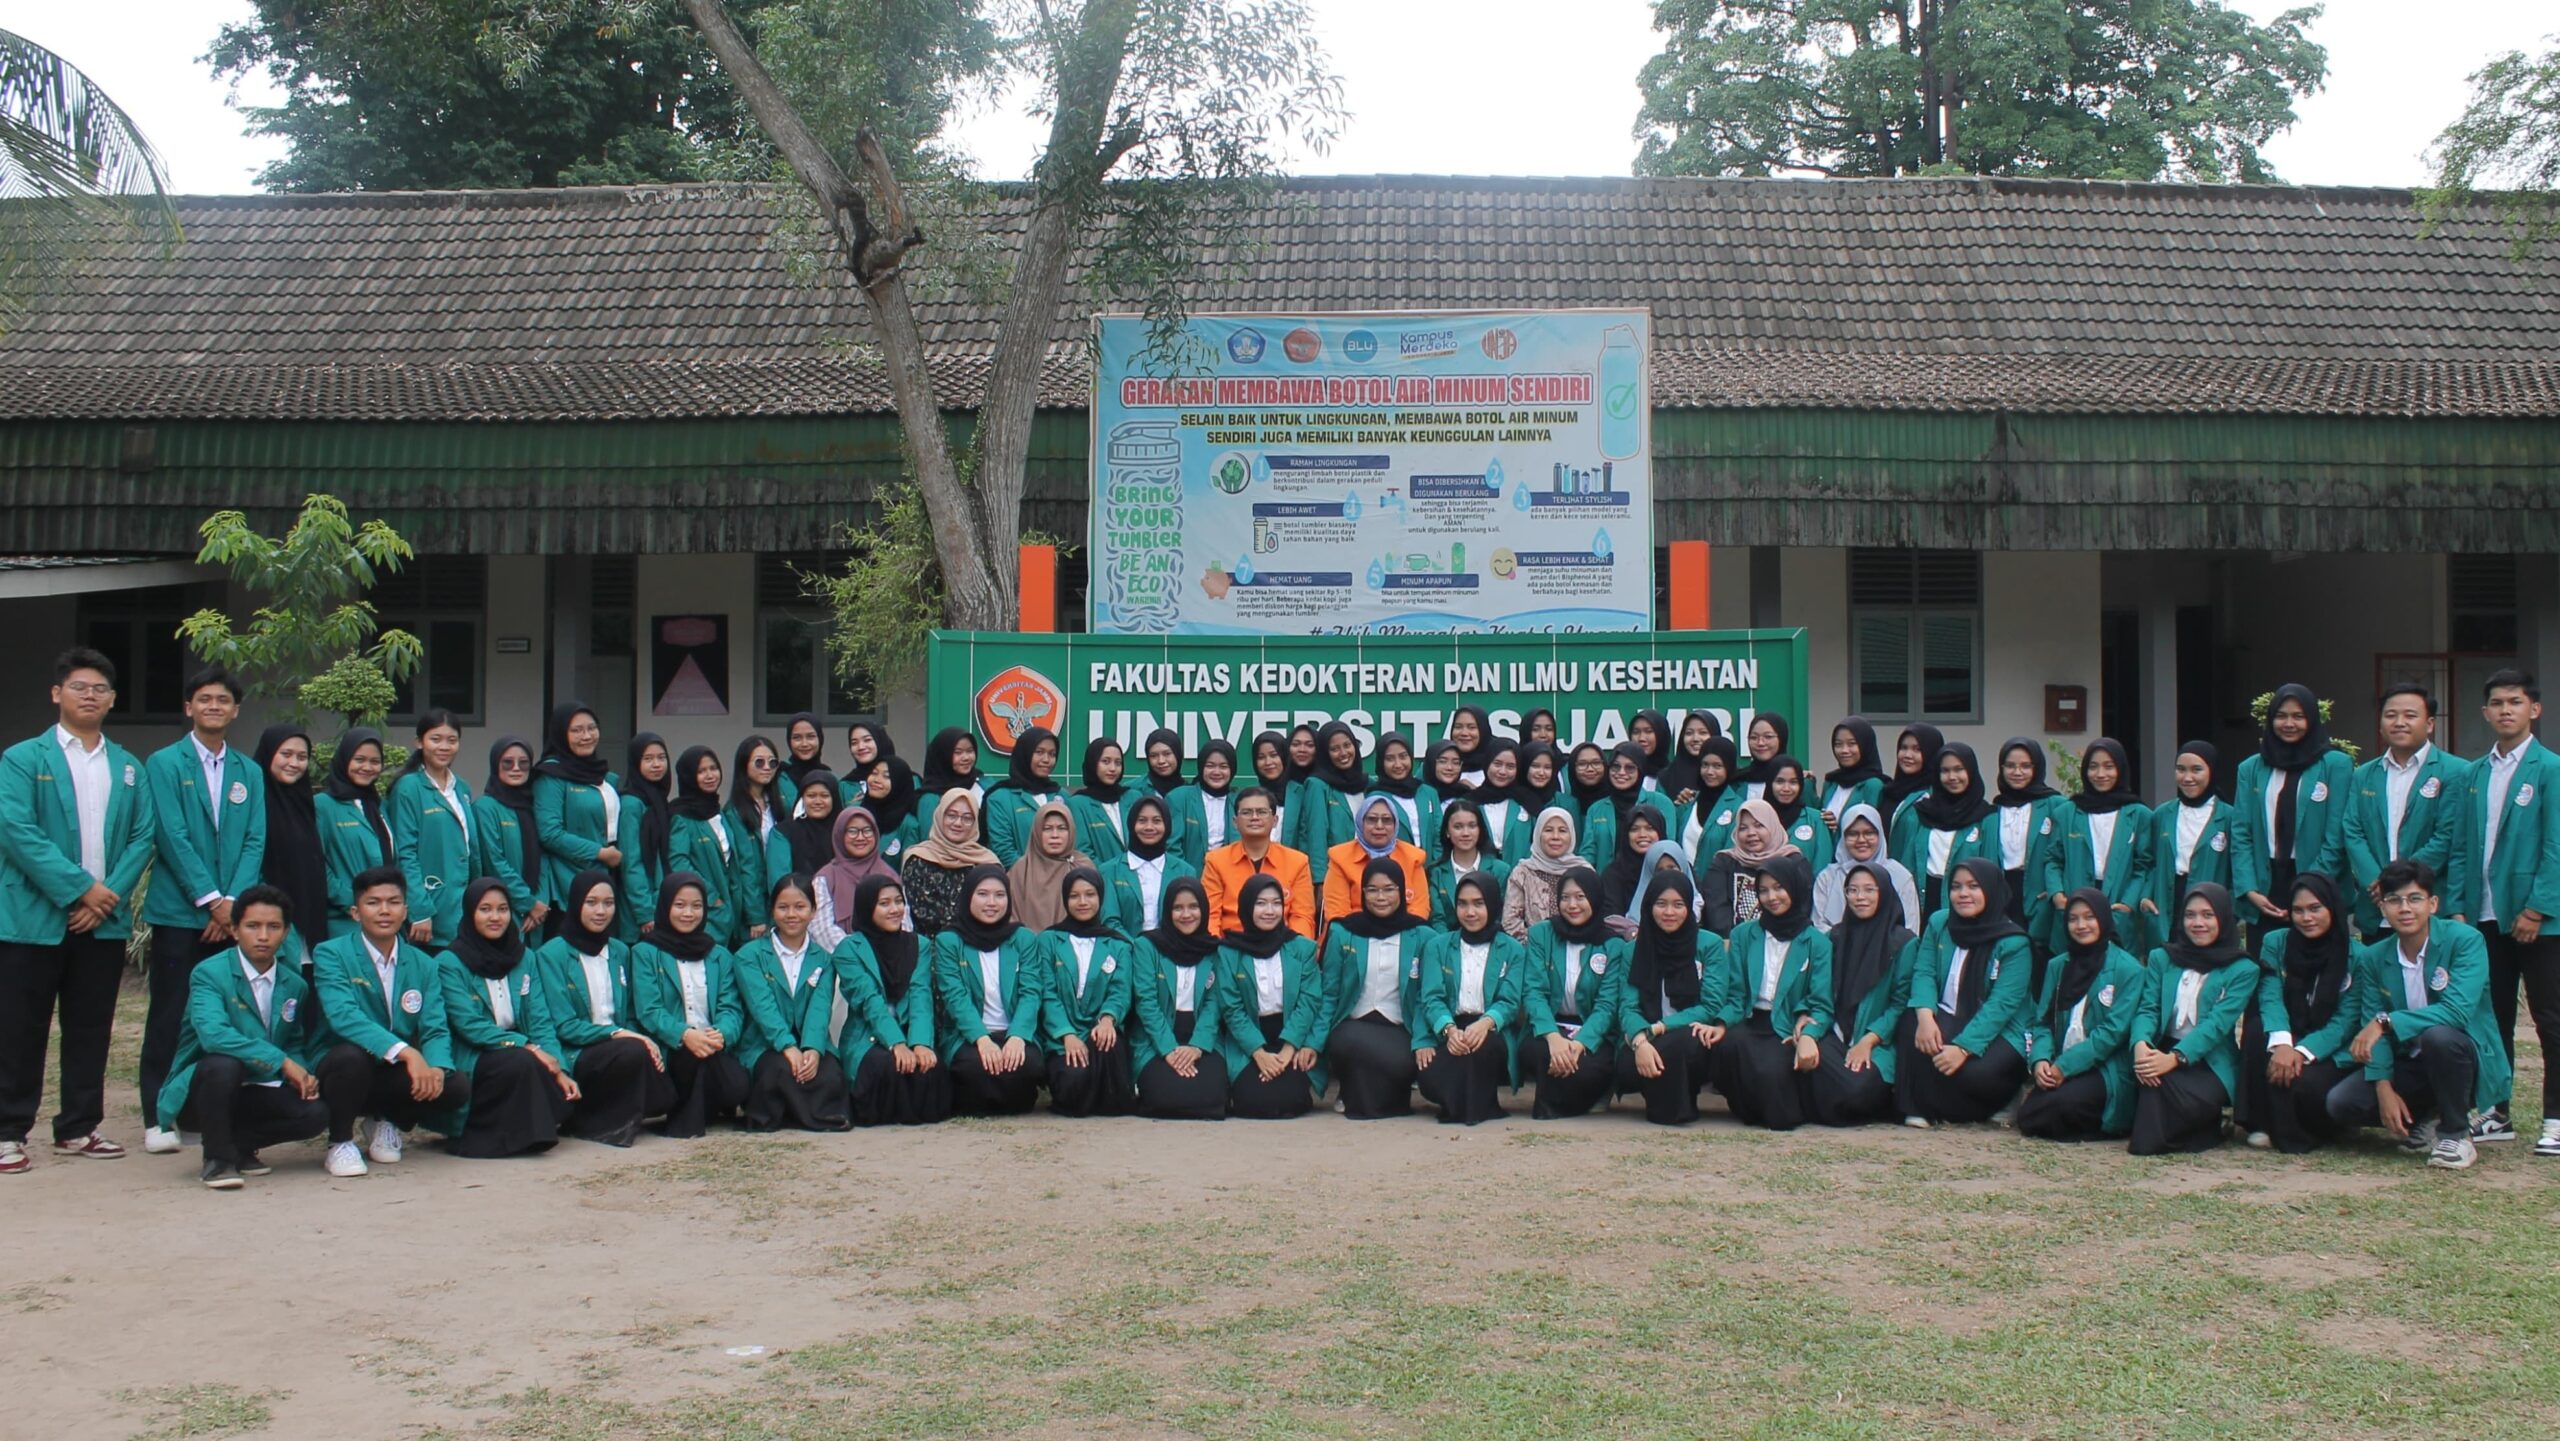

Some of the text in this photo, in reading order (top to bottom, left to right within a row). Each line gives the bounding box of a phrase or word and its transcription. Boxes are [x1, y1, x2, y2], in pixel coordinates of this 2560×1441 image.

[1400, 330, 1454, 344] Kampus
[1347, 339, 1374, 351] BLU
[1400, 340, 1458, 354] Merdeka
[1122, 376, 1591, 405] GERAKAN MEMBAWA BOTOL AIR MINUM SENDIRI
[1180, 411, 1579, 427] SELAIN BAIK UNTUK LINGKUNGAN, MEMBAWA BOTOL AIR MINUM
[1207, 429, 1552, 443] SENDIRI JUGA MEMILIKI BANYAK KEUNGGULAN LAINNYA
[1289, 459, 1358, 467] RAMAH LINGKUNGAN
[1273, 471, 1311, 479] mengurangi
[1351, 470, 1373, 478] plastik
[1337, 477, 1362, 485] gerakan
[1363, 476, 1383, 484] peduli
[1418, 478, 1434, 486] BISA
[1435, 478, 1480, 486] DIBERSIHKAN
[1414, 489, 1489, 497] DIGUNAKAN BERULANG
[1552, 496, 1613, 504] TERLIHAT STYLISH
[1277, 506, 1317, 514] LEBIH AWET
[1114, 508, 1175, 527] YOUR
[1119, 554, 1171, 573] BE AN
[1522, 556, 1540, 564] RASA
[1541, 556, 1561, 564] LEBIH
[1561, 556, 1580, 564] ENAK
[1587, 556, 1609, 564] SEHAT
[1239, 562, 1250, 580] 7
[1269, 576, 1312, 584] HEMAT UANG
[1369, 570, 1380, 587] 5
[1401, 577, 1452, 585] MINUM APAPUN
[1561, 574, 1592, 582] Bisphenol
[1127, 574, 1162, 593] ECO
[1532, 588, 1564, 596] berbahaya
[1565, 588, 1579, 596] bagi
[1090, 658, 1758, 694] FAKULTAS KEDOKTERAN DAN ILMU KESEHATAN
